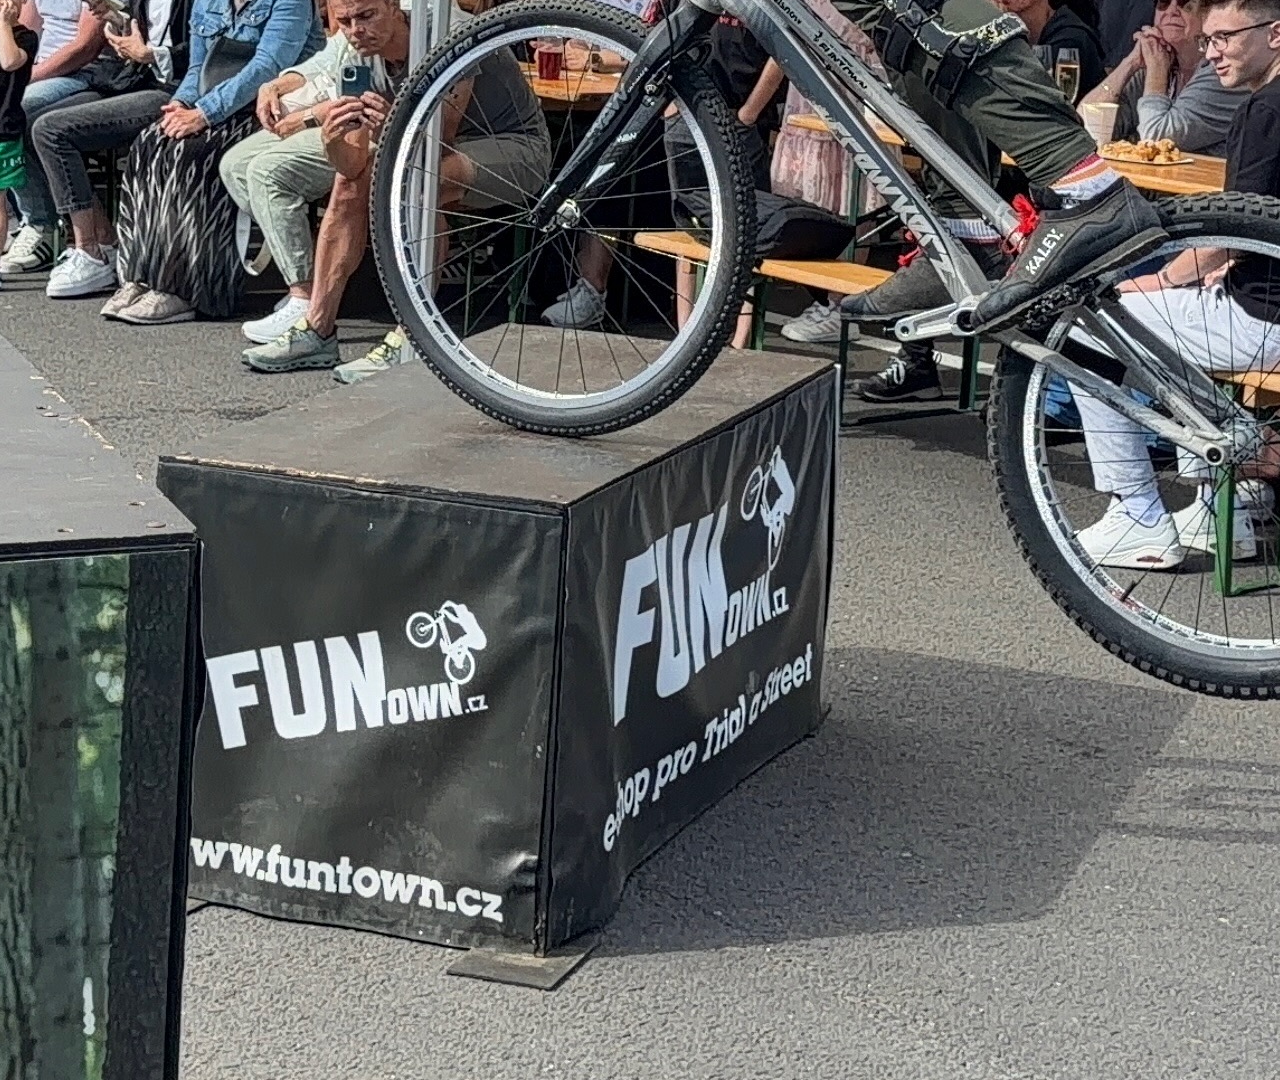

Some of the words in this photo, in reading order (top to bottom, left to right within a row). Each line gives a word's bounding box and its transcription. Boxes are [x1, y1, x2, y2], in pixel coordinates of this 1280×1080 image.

[651, 740, 698, 802] pro
[701, 693, 747, 762] Trial
[759, 642, 813, 713] street
[190, 837, 504, 923] ww.funtown.cz
